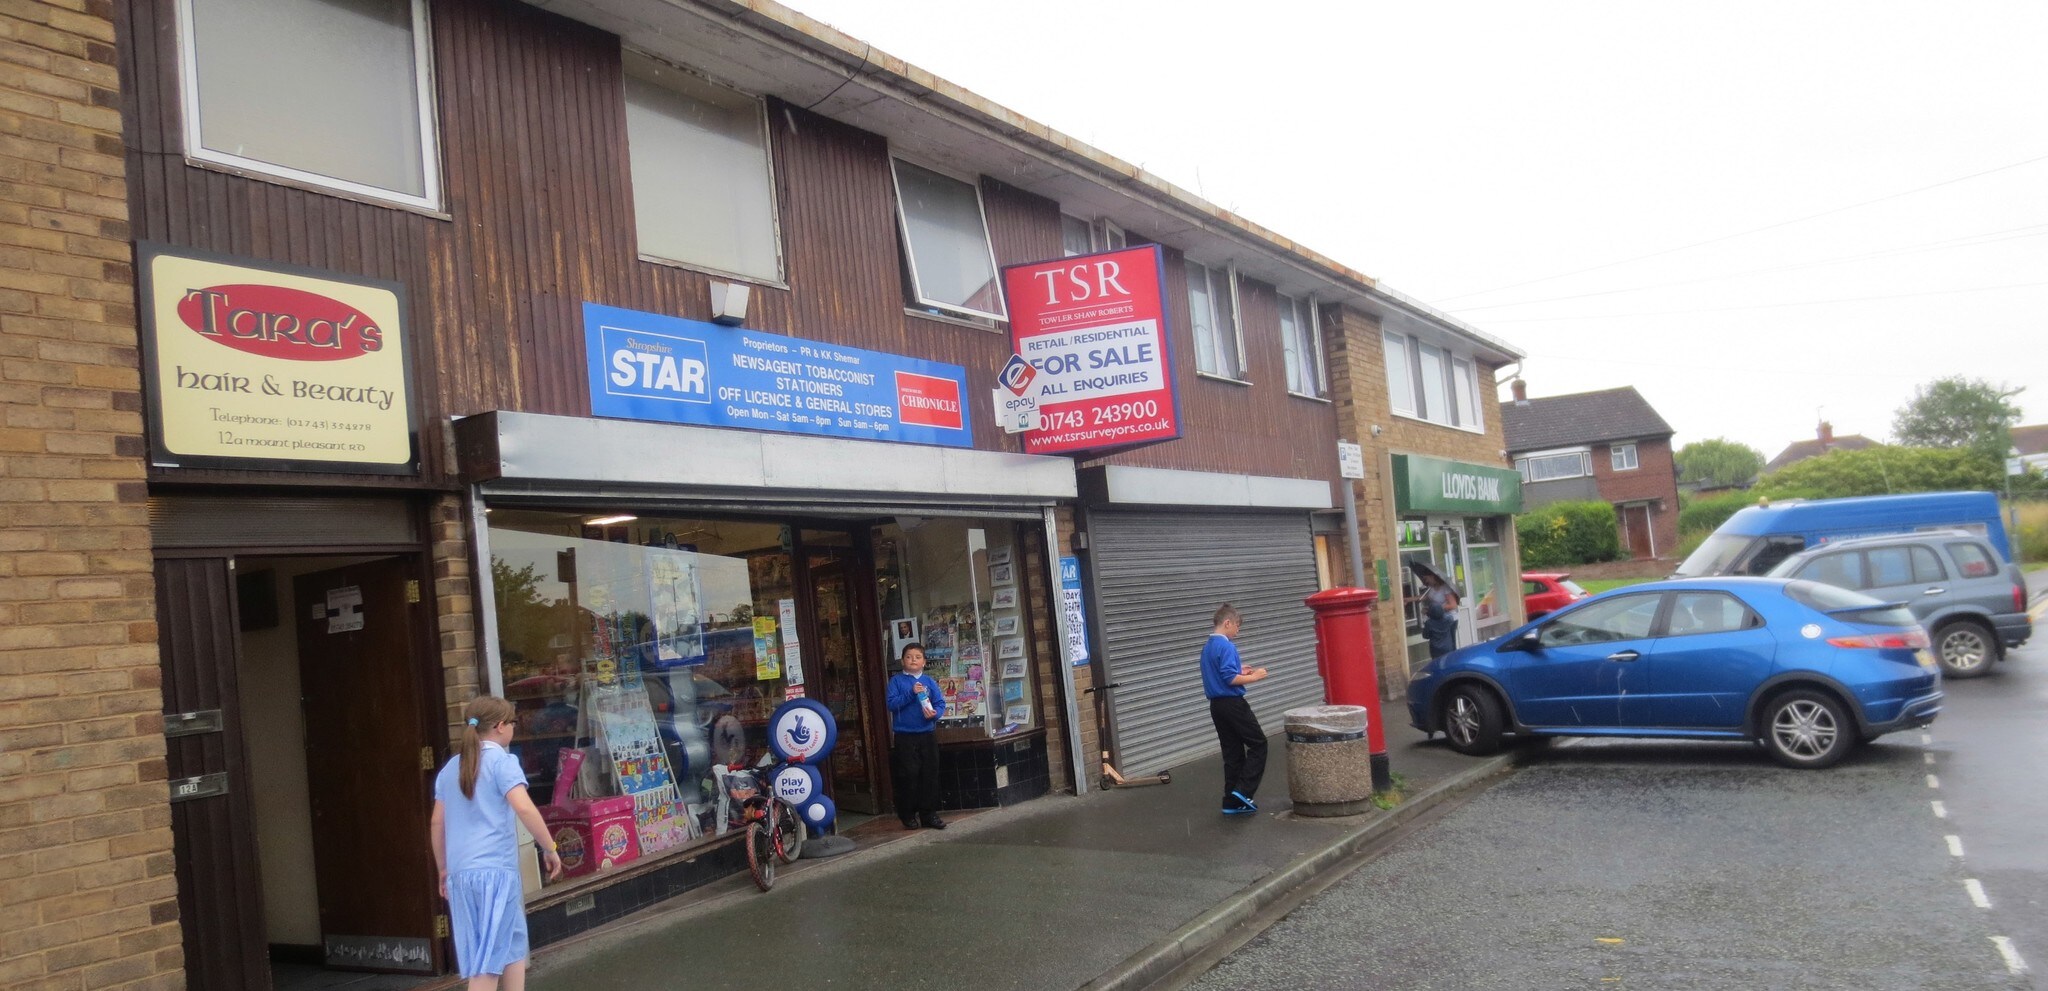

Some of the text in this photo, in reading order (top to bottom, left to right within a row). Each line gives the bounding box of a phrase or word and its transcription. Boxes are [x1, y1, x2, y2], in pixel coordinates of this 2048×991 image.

[1034, 260, 1131, 306] TSR
[186, 288, 383, 353] Tara's
[1039, 305, 1134, 325] TOWLER SHAW ROBERTS
[626, 337, 673, 354] Shropshire
[742, 336, 788, 354] Proprietors
[800, 346, 812, 357] PR
[814, 349, 820, 358] &
[820, 350, 832, 360] KK
[834, 352, 860, 364] Shemar
[611, 349, 705, 394] STAR
[732, 353, 875, 386] NEWSAGENT TOBACCONIST
[1029, 343, 1153, 376] FOR SALE
[176, 366, 253, 394] hair
[261, 374, 285, 397] &
[776, 376, 843, 397] STATIONERS
[1040, 371, 1149, 396] ALL ENQUIRIES
[719, 386, 892, 418] OFF LICENCE & GENERAL STORES
[902, 394, 958, 412] CHRONICLE
[1006, 396, 1036, 411] epay
[210, 407, 282, 425] Telephone:
[286, 416, 329, 430] (01743)
[726, 405, 750, 418] Open
[752, 408, 768, 420] Mon
[776, 410, 790, 422] Sat
[838, 417, 852, 428] Sun
[1040, 400, 1158, 432] 01743 243900
[218, 430, 243, 445] 12a
[246, 438, 290, 448] mount
[292, 440, 345, 450] pleasant
[1030, 418, 1170, 446] www.tsrsurveyors.co.uk
[1442, 471, 1500, 502] LLOYDS BANK
[788, 742, 810, 752] National
[809, 730, 820, 749] Lottery
[181, 784, 198, 794] 12A
[781, 787, 806, 796] here
[782, 778, 804, 788] Play
